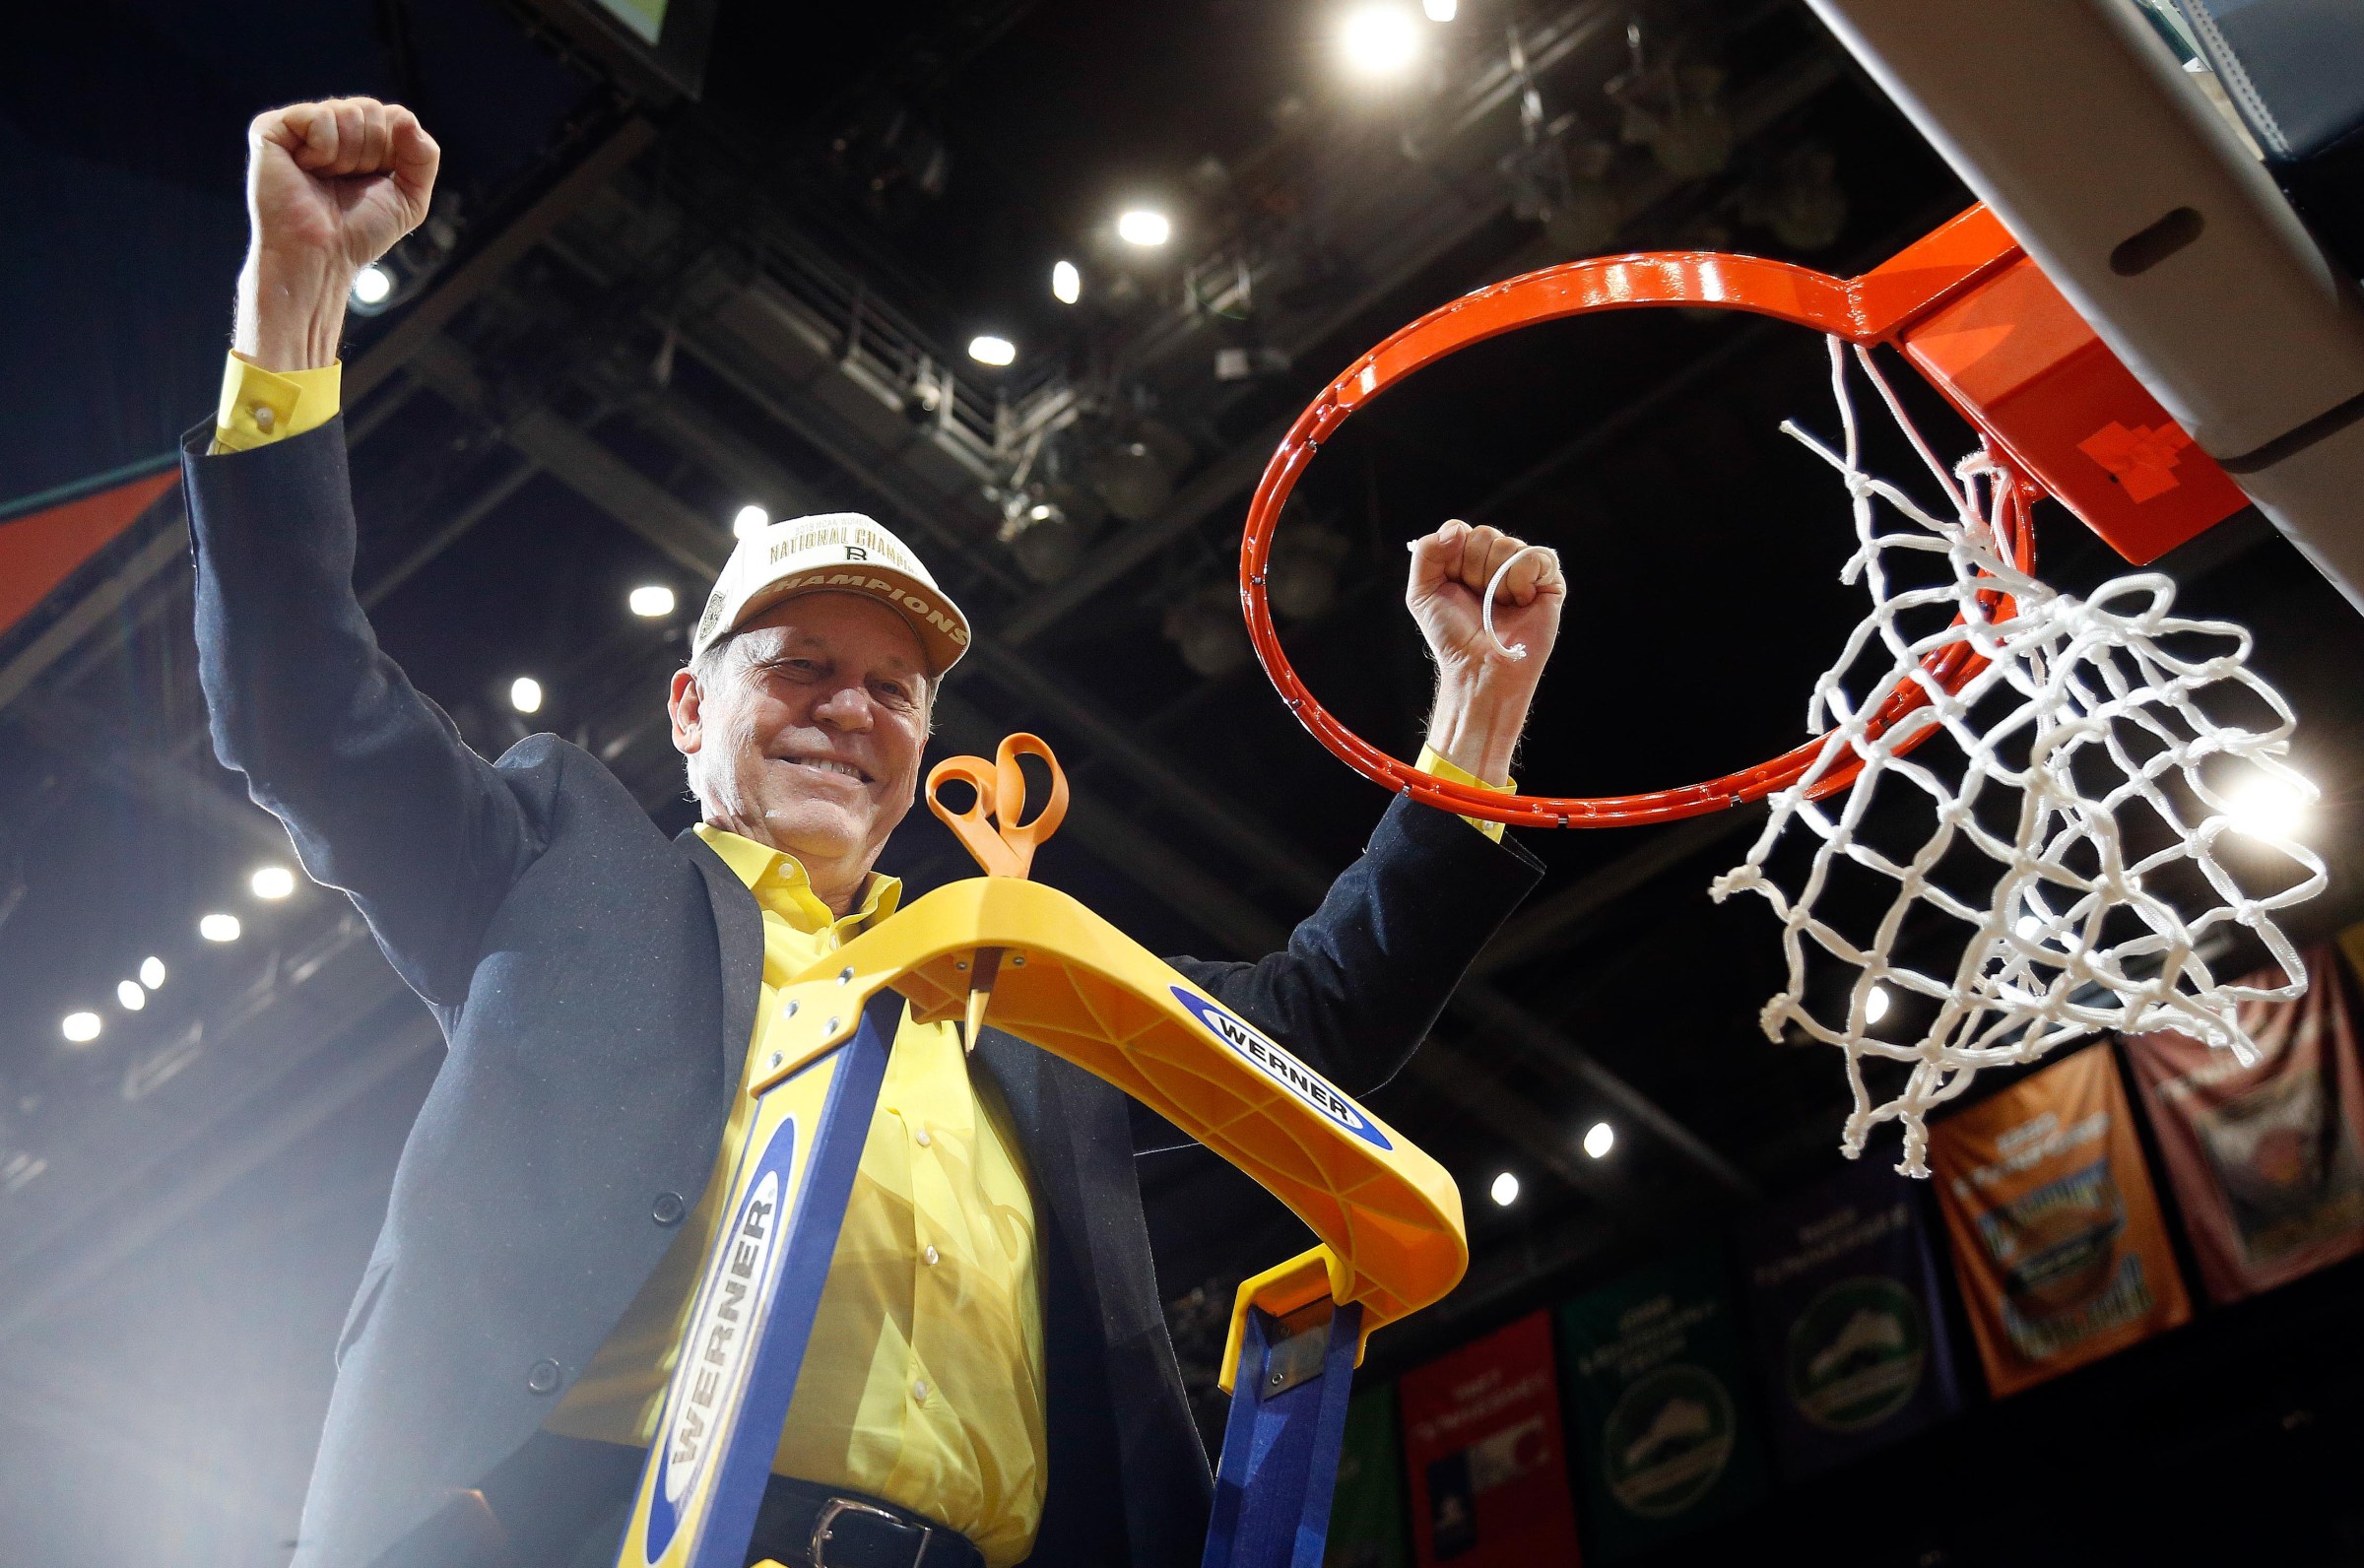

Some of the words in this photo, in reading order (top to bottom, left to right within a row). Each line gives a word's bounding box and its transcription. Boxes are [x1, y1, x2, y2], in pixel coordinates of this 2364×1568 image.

[770, 526, 848, 564] NATIONAL
[1219, 1016, 1348, 1122] WERNER
[672, 1198, 773, 1466] WERNER
